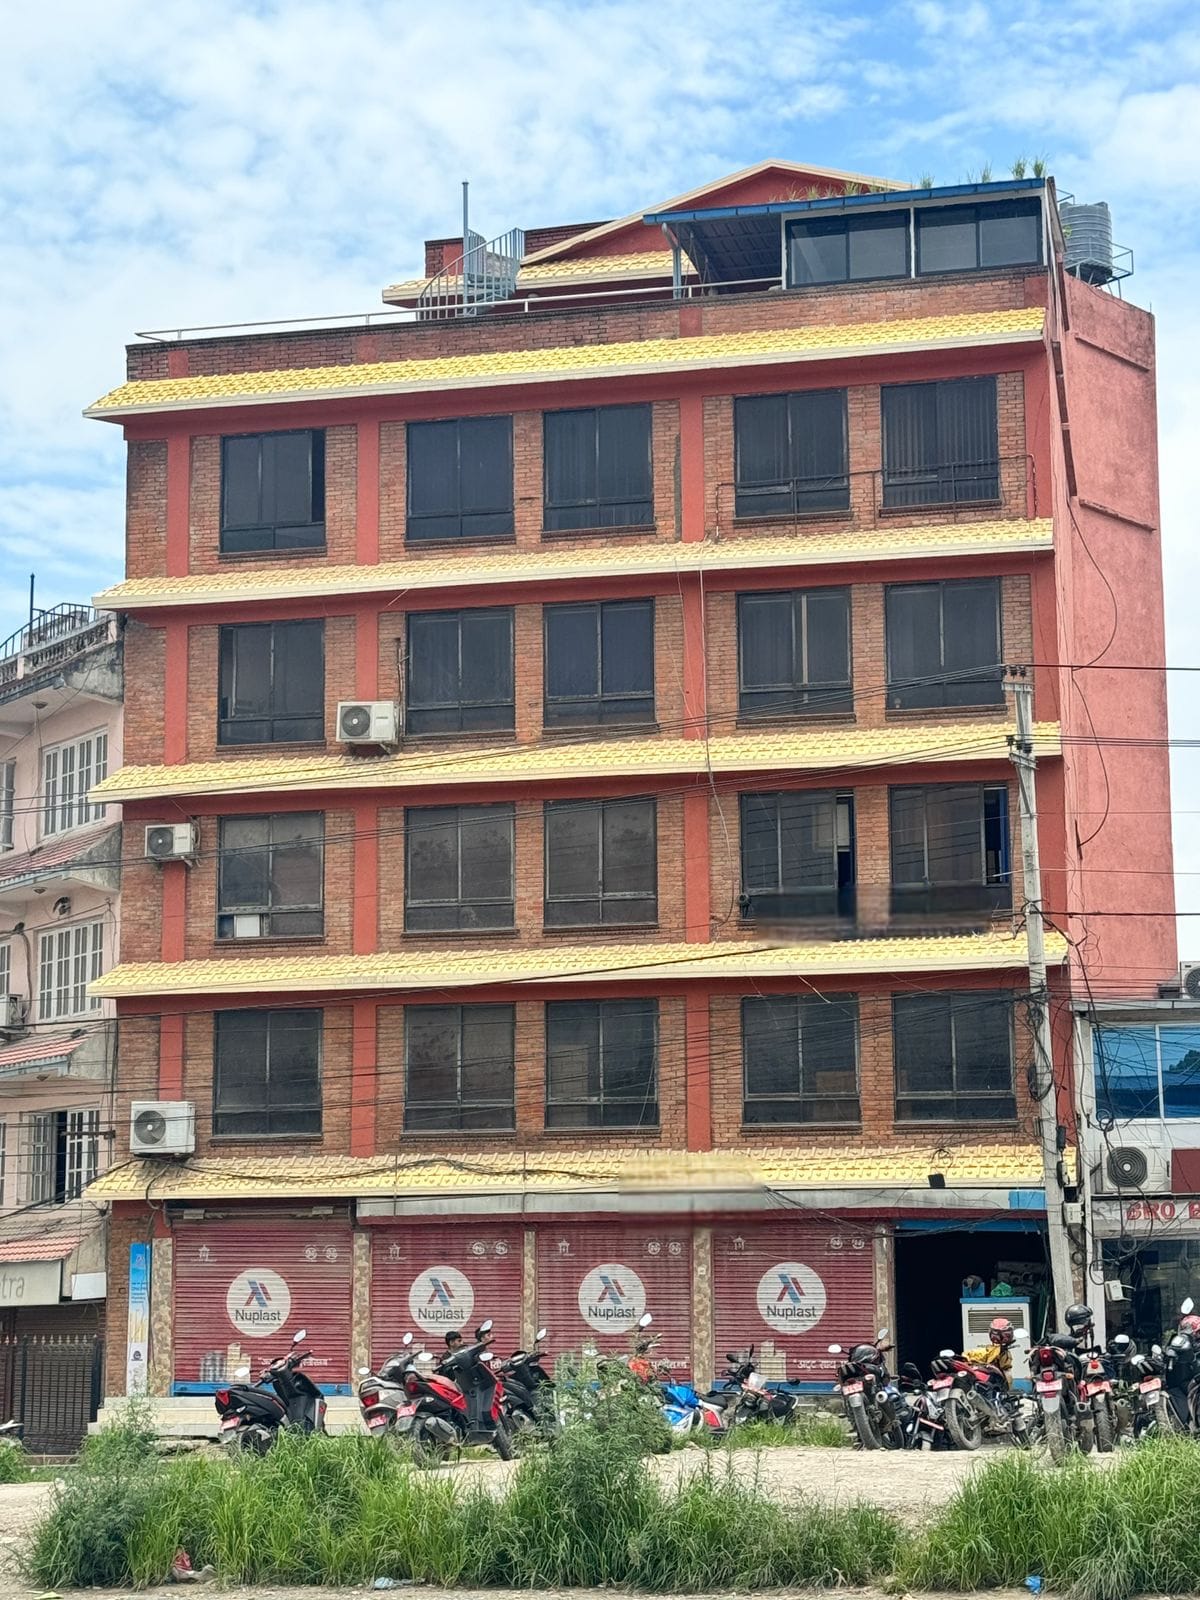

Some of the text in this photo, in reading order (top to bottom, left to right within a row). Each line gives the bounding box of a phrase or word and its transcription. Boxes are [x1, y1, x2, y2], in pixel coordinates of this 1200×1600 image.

[235, 1309, 282, 1324] Nuplast
[418, 1307, 465, 1321] Nuplast
[588, 1305, 637, 1320] Nuplast
[767, 1305, 817, 1320] Nuplast
